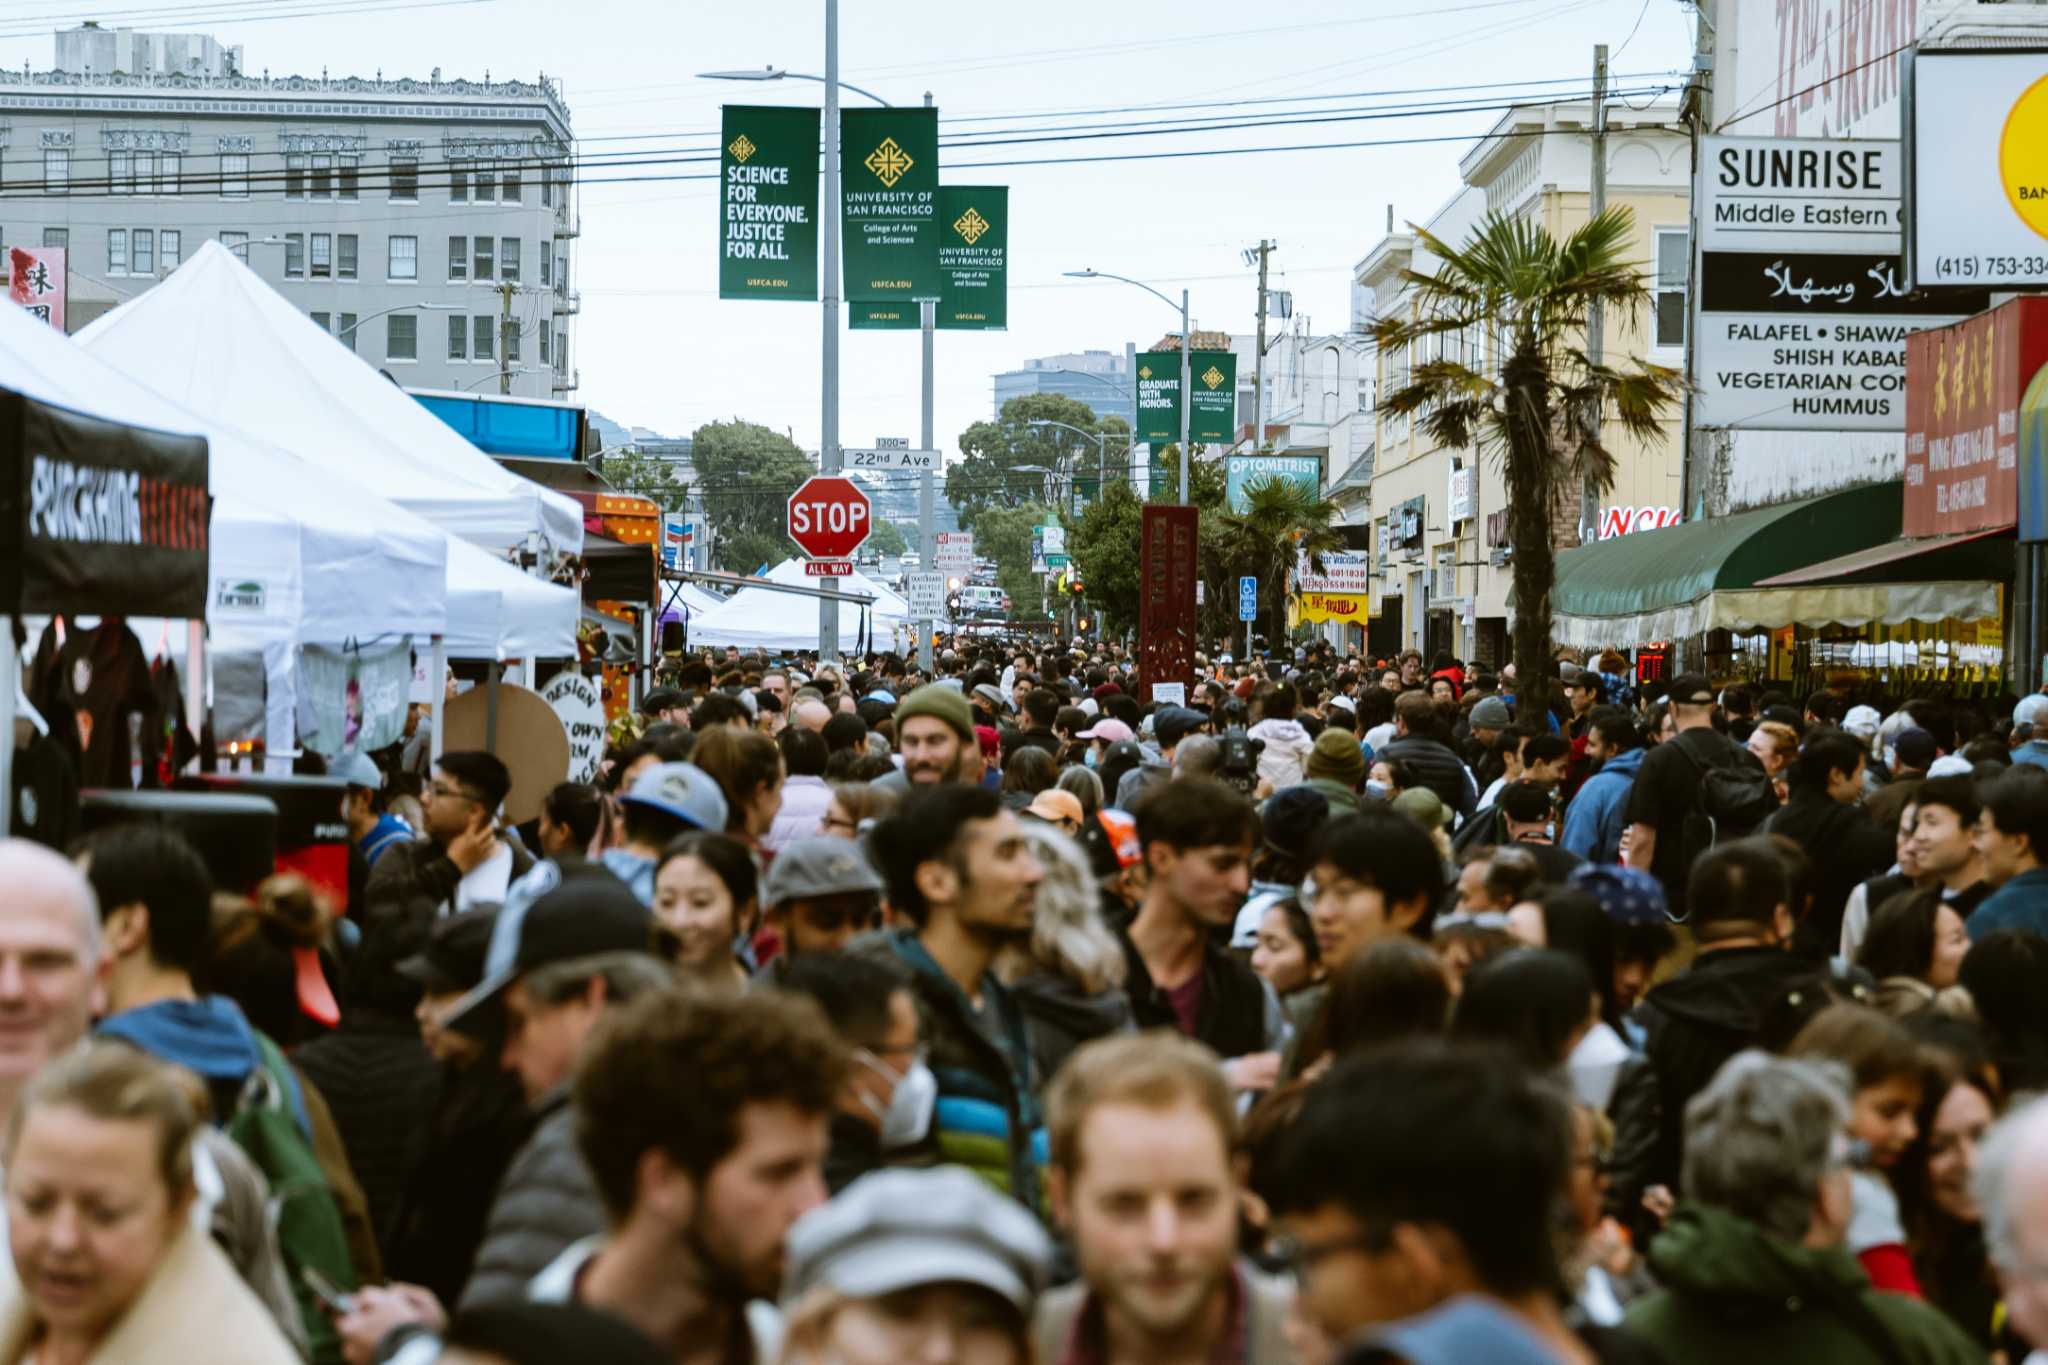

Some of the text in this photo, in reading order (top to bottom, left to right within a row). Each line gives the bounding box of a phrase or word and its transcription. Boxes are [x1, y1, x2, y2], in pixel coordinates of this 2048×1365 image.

[727, 166, 789, 184] SCIENCE
[1719, 148, 1882, 189] SUNRISE
[727, 184, 756, 202] FOR
[847, 192, 932, 202] UNIVERSITY OF
[727, 204, 808, 223] EVERYONE.
[847, 205, 933, 215] SAN FRANCISCO
[1715, 203, 1887, 224] Middle Eastern
[726, 222, 785, 240] JUSTICE
[863, 224, 917, 234] College of Arts
[867, 236, 914, 244] and Sciences
[726, 241, 789, 260] FOR ALL.
[939, 248, 989, 256] UNIVERSITY
[939, 257, 1003, 266] SAN FRANCISCO
[1936, 256, 1979, 279] (415)
[747, 279, 788, 287] USFCA.EDU
[871, 280, 912, 288] USFCA.EDU
[1728, 324, 1812, 341] FALAFEL
[1773, 349, 1833, 365] SHISH
[1140, 380, 1178, 389] GRADUATE
[1717, 372, 1851, 390] VEGETARIAN
[1140, 390, 1160, 398] WITH
[1140, 399, 1173, 408] HONORS.
[1793, 398, 1890, 415] HUMMUS
[877, 438, 898, 448] 1300
[854, 452, 930, 467] 22nd Ave
[1230, 458, 1317, 474] OPTOMETRIST
[793, 502, 866, 533] STOP
[809, 563, 850, 575] ALL WAY
[571, 722, 603, 739] OWN
